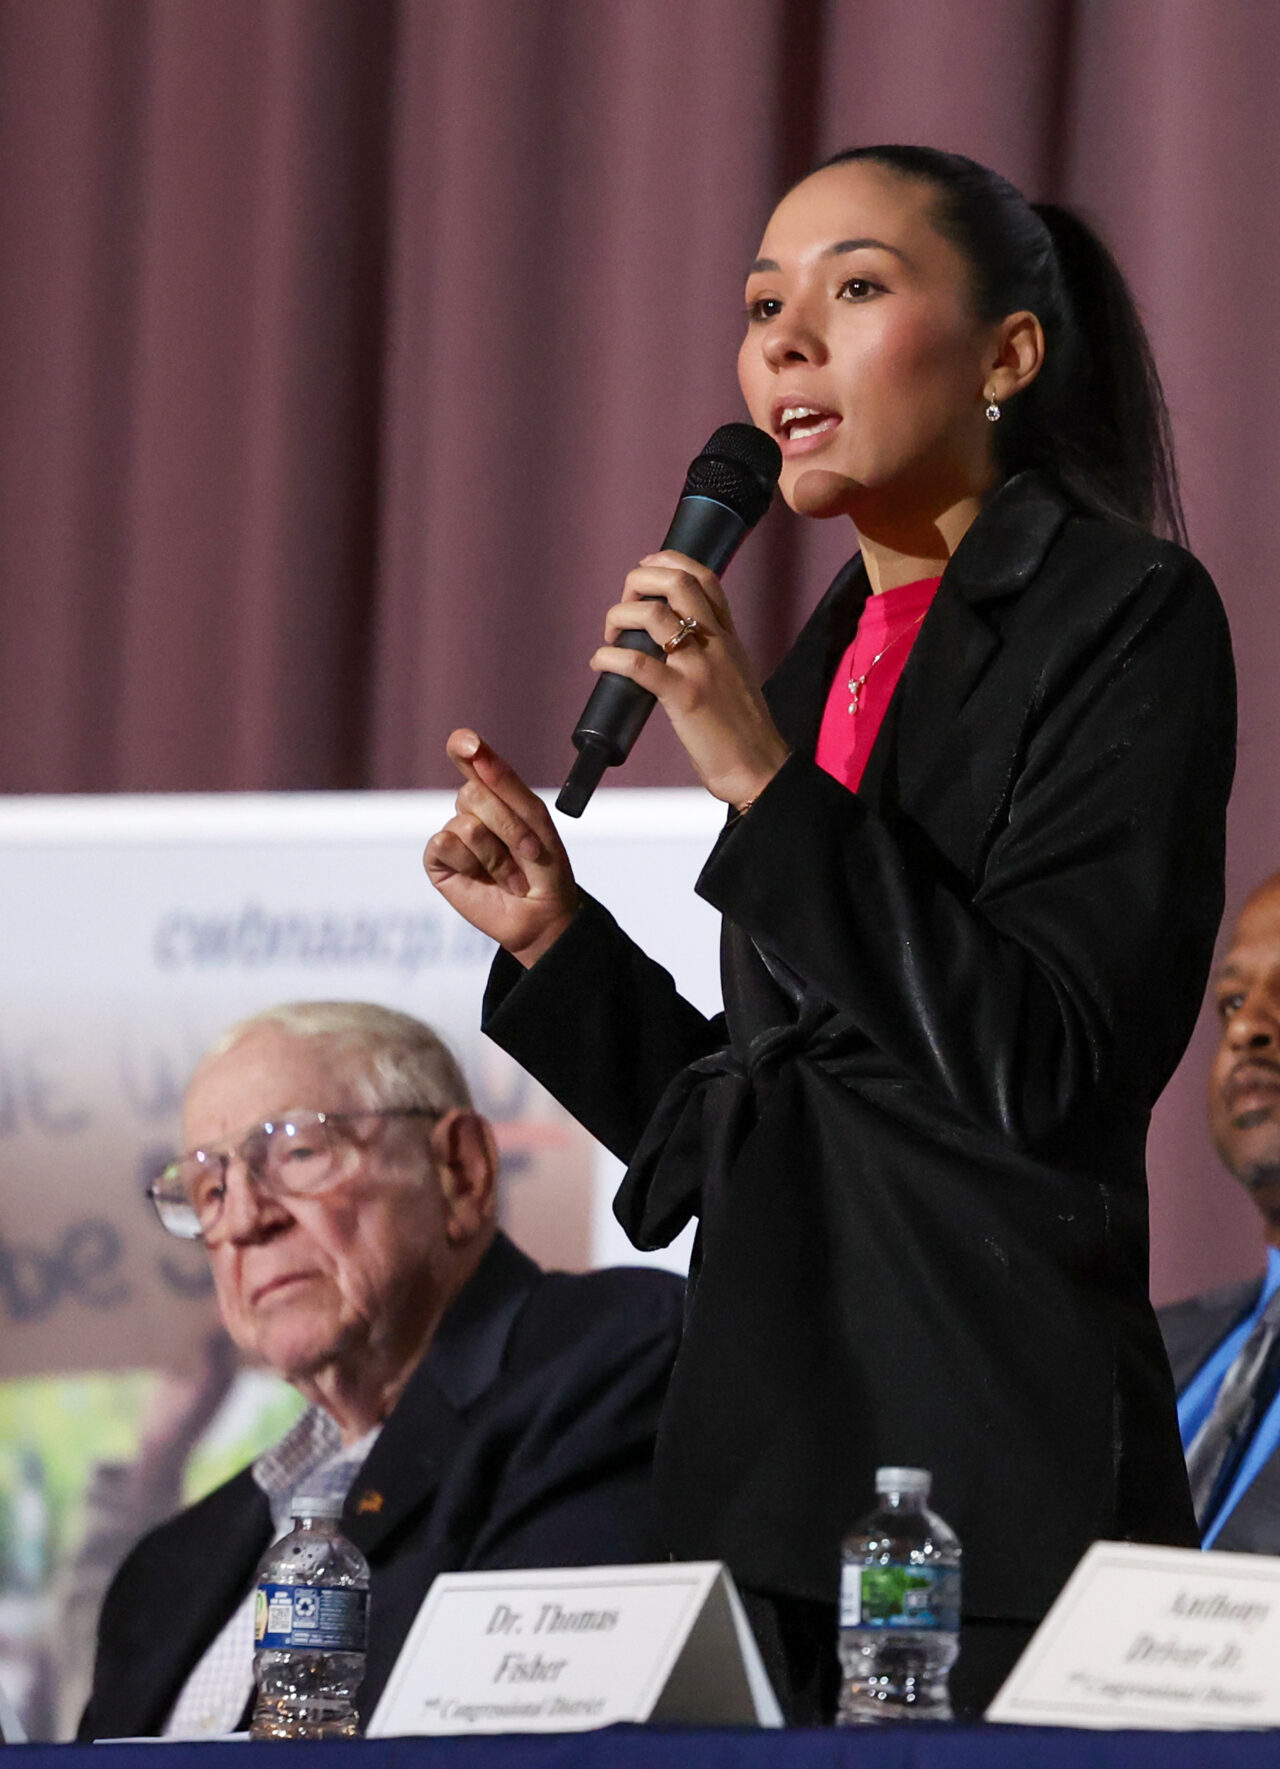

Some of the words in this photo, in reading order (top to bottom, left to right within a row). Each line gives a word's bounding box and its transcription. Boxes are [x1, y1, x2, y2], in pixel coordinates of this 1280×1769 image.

[486, 1604, 523, 1635] Dr.
[534, 1603, 620, 1634] Thomas
[493, 1652, 568, 1684] Fisher
